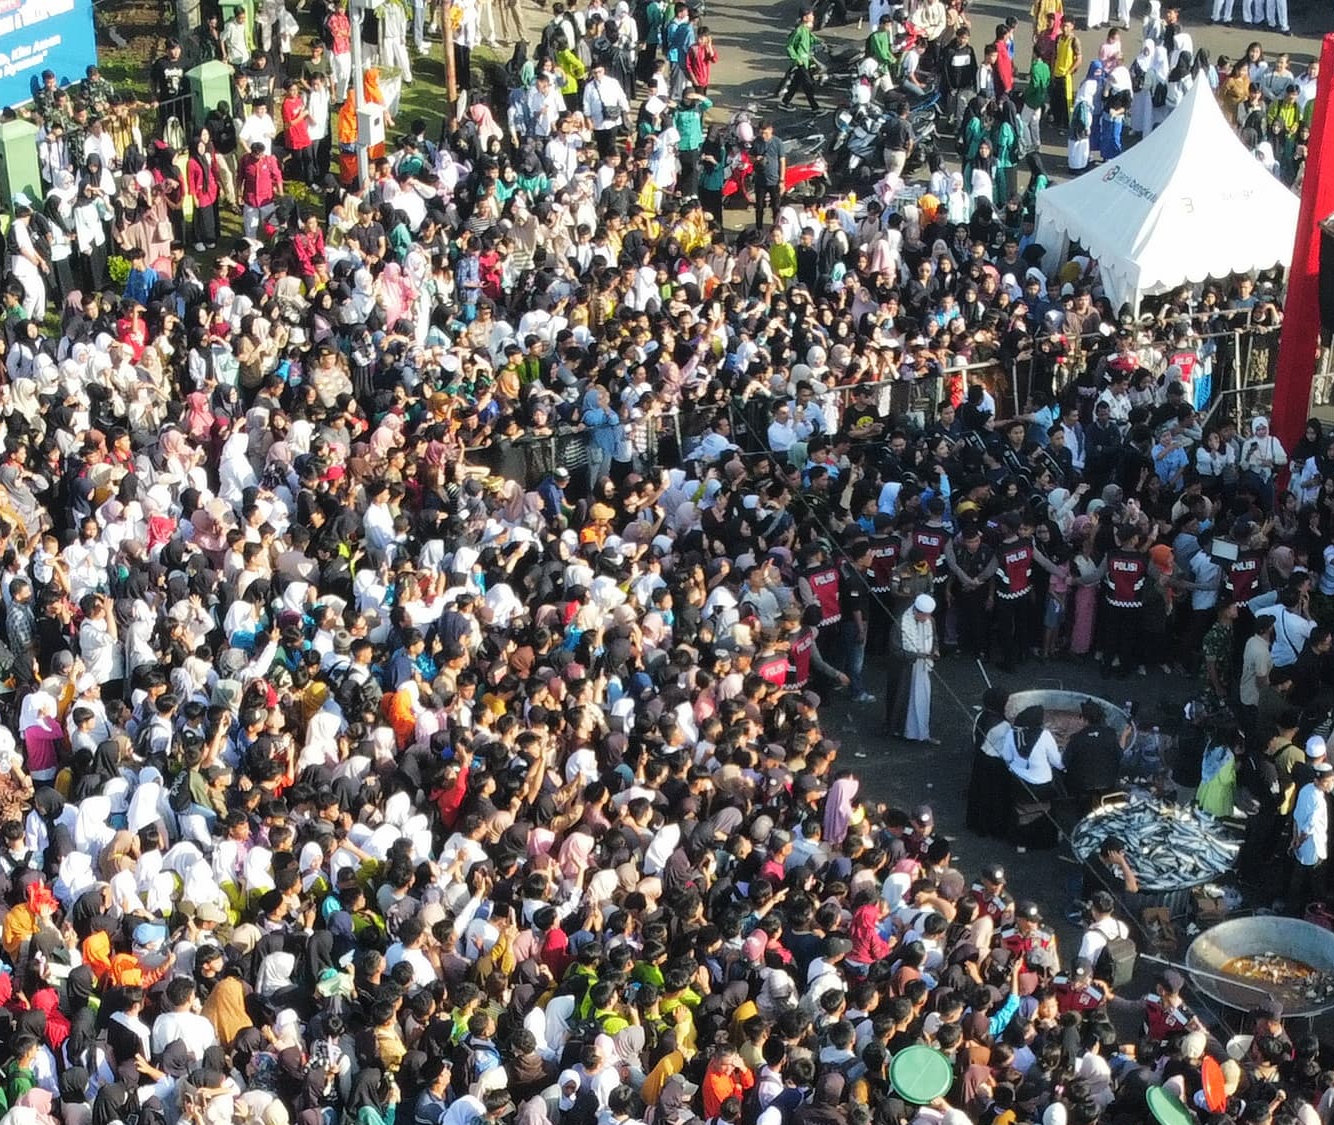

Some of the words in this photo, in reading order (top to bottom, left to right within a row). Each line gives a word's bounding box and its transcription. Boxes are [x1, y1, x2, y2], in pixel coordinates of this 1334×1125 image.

[917, 534, 940, 547] POLISI
[870, 547, 895, 559] POLISI
[1005, 550, 1028, 564] POLISI
[1113, 560, 1138, 572] POLISI
[1231, 560, 1256, 572] POLISI
[814, 571, 837, 587] POLISI
[766, 662, 788, 677] POLISI
